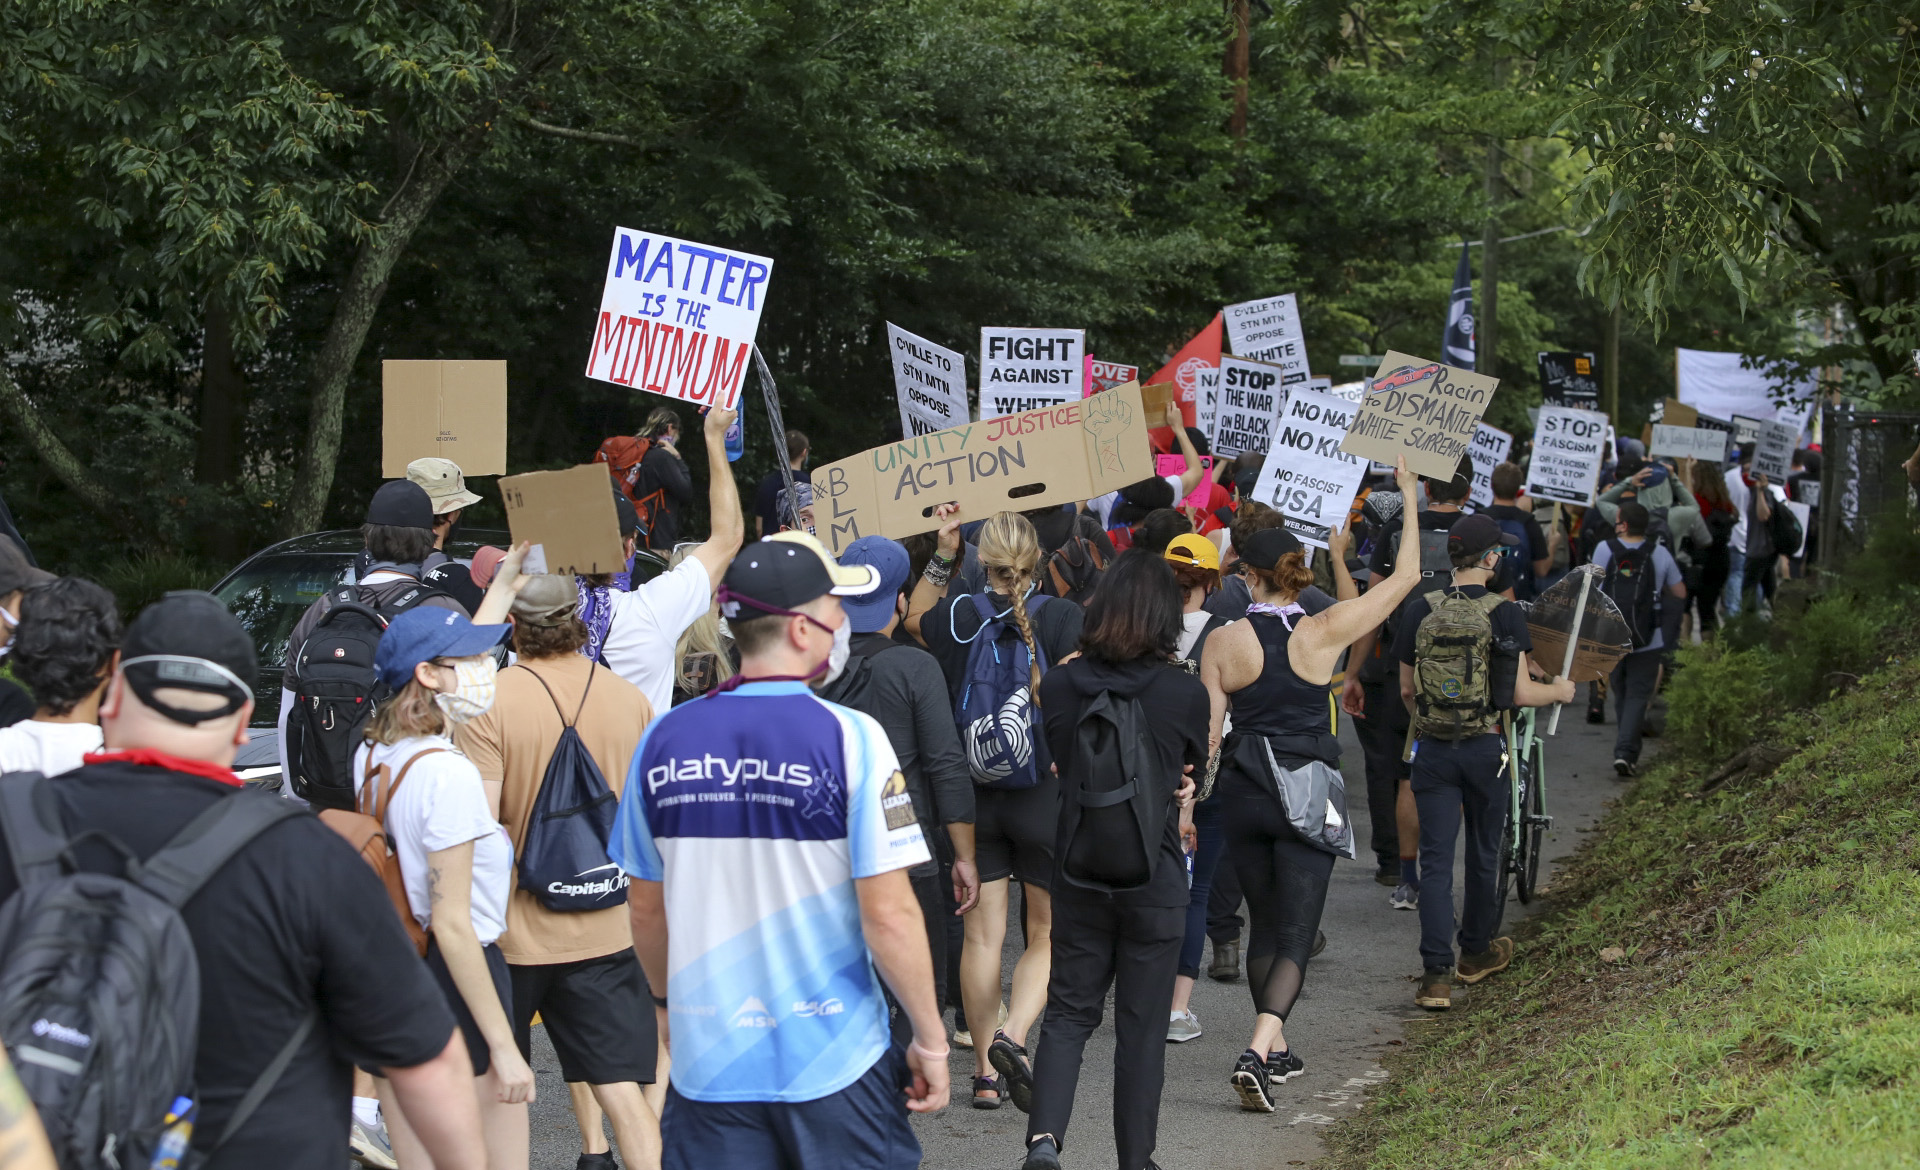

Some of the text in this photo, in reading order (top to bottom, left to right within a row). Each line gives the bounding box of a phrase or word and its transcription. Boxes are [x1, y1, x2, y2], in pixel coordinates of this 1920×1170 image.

[615, 234, 768, 311] MATTER
[638, 292, 711, 330] IS THE
[1270, 300, 1285, 309] TO
[1240, 314, 1285, 330] STN MTN
[1245, 328, 1285, 342] OPPOSE
[588, 311, 749, 408] MINIMUM
[989, 337, 1075, 362] FIGHT
[934, 354, 951, 371] TO
[1092, 363, 1130, 382] OVE
[1545, 360, 1566, 379] No
[903, 362, 951, 395] STN MTN
[990, 368, 1073, 384] AGAINST
[1225, 367, 1276, 391] STOP
[908, 387, 951, 418] OPPOSE
[1225, 388, 1245, 408] THE
[1246, 391, 1273, 412] WAR
[1291, 400, 1320, 421] NO
[1221, 413, 1270, 436] ON BLACK
[1350, 410, 1404, 440] WHITE
[1365, 391, 1482, 435] to DISMANTLE
[874, 426, 972, 473] UNITY
[986, 405, 1082, 442] JUSTICE
[1280, 426, 1314, 451] NO
[1545, 416, 1601, 438] STOP
[1217, 428, 1271, 454] AMERICA!
[1472, 428, 1506, 453] IGHT
[1541, 436, 1597, 453] FASCISM
[1468, 447, 1500, 468] GAINST
[1539, 456, 1551, 464] OR
[1757, 460, 1784, 475] HATE
[894, 440, 1026, 501] ACTION
[1274, 468, 1343, 495] NO FASCIST
[1540, 466, 1586, 479] WILL STOP
[1560, 480, 1576, 489] ALL
[1272, 483, 1323, 518] USA
[647, 752, 813, 795] platypus
[736, 1016, 777, 1028] MSR
